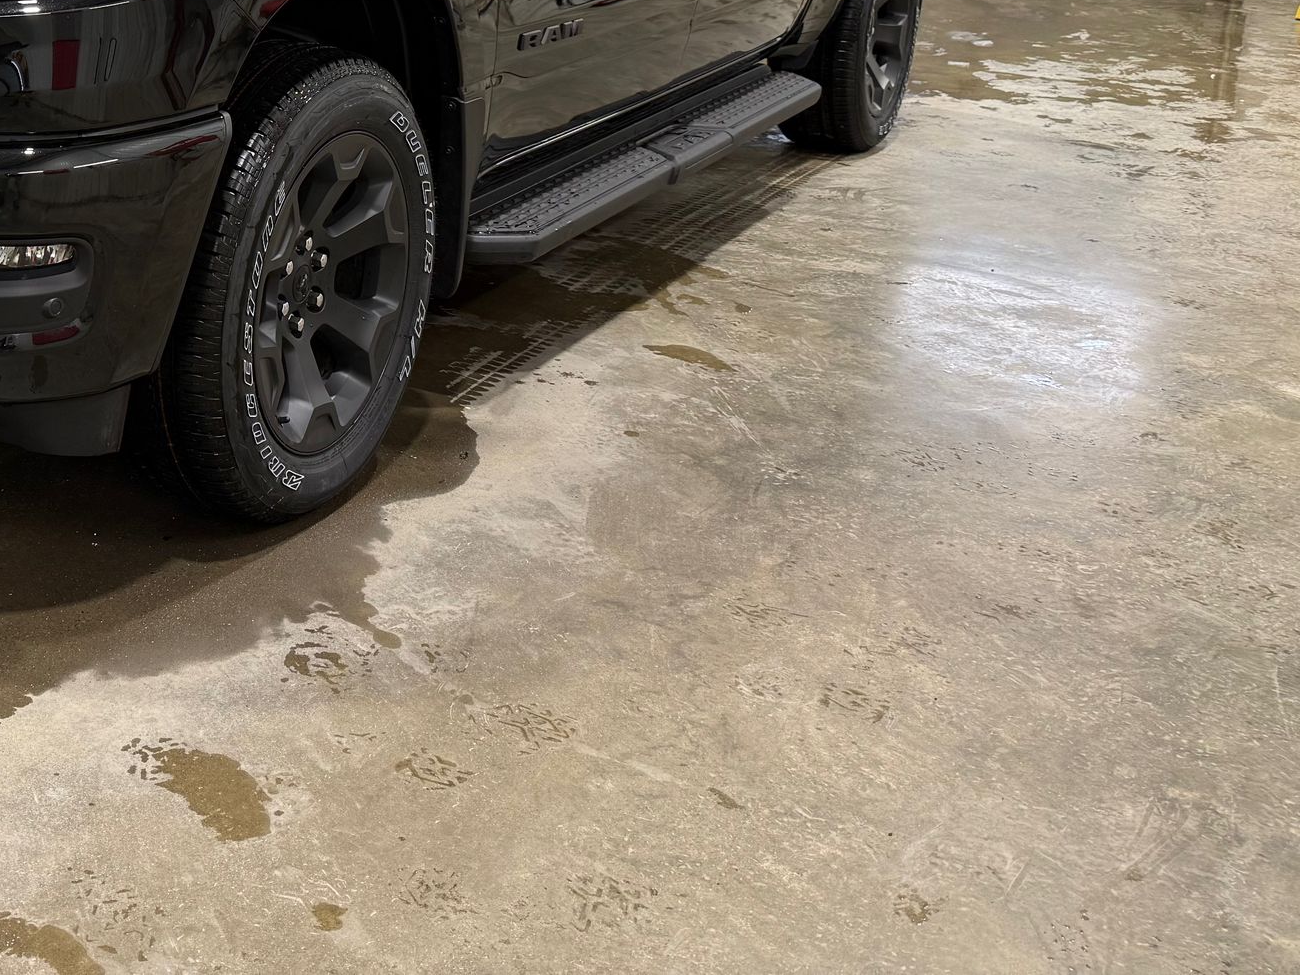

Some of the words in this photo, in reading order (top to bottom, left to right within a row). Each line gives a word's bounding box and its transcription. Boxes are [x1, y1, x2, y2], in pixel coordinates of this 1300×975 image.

[516, 18, 584, 52] RAM
[389, 111, 435, 276] DUELER
[243, 180, 305, 491] BRIDGESTONE
